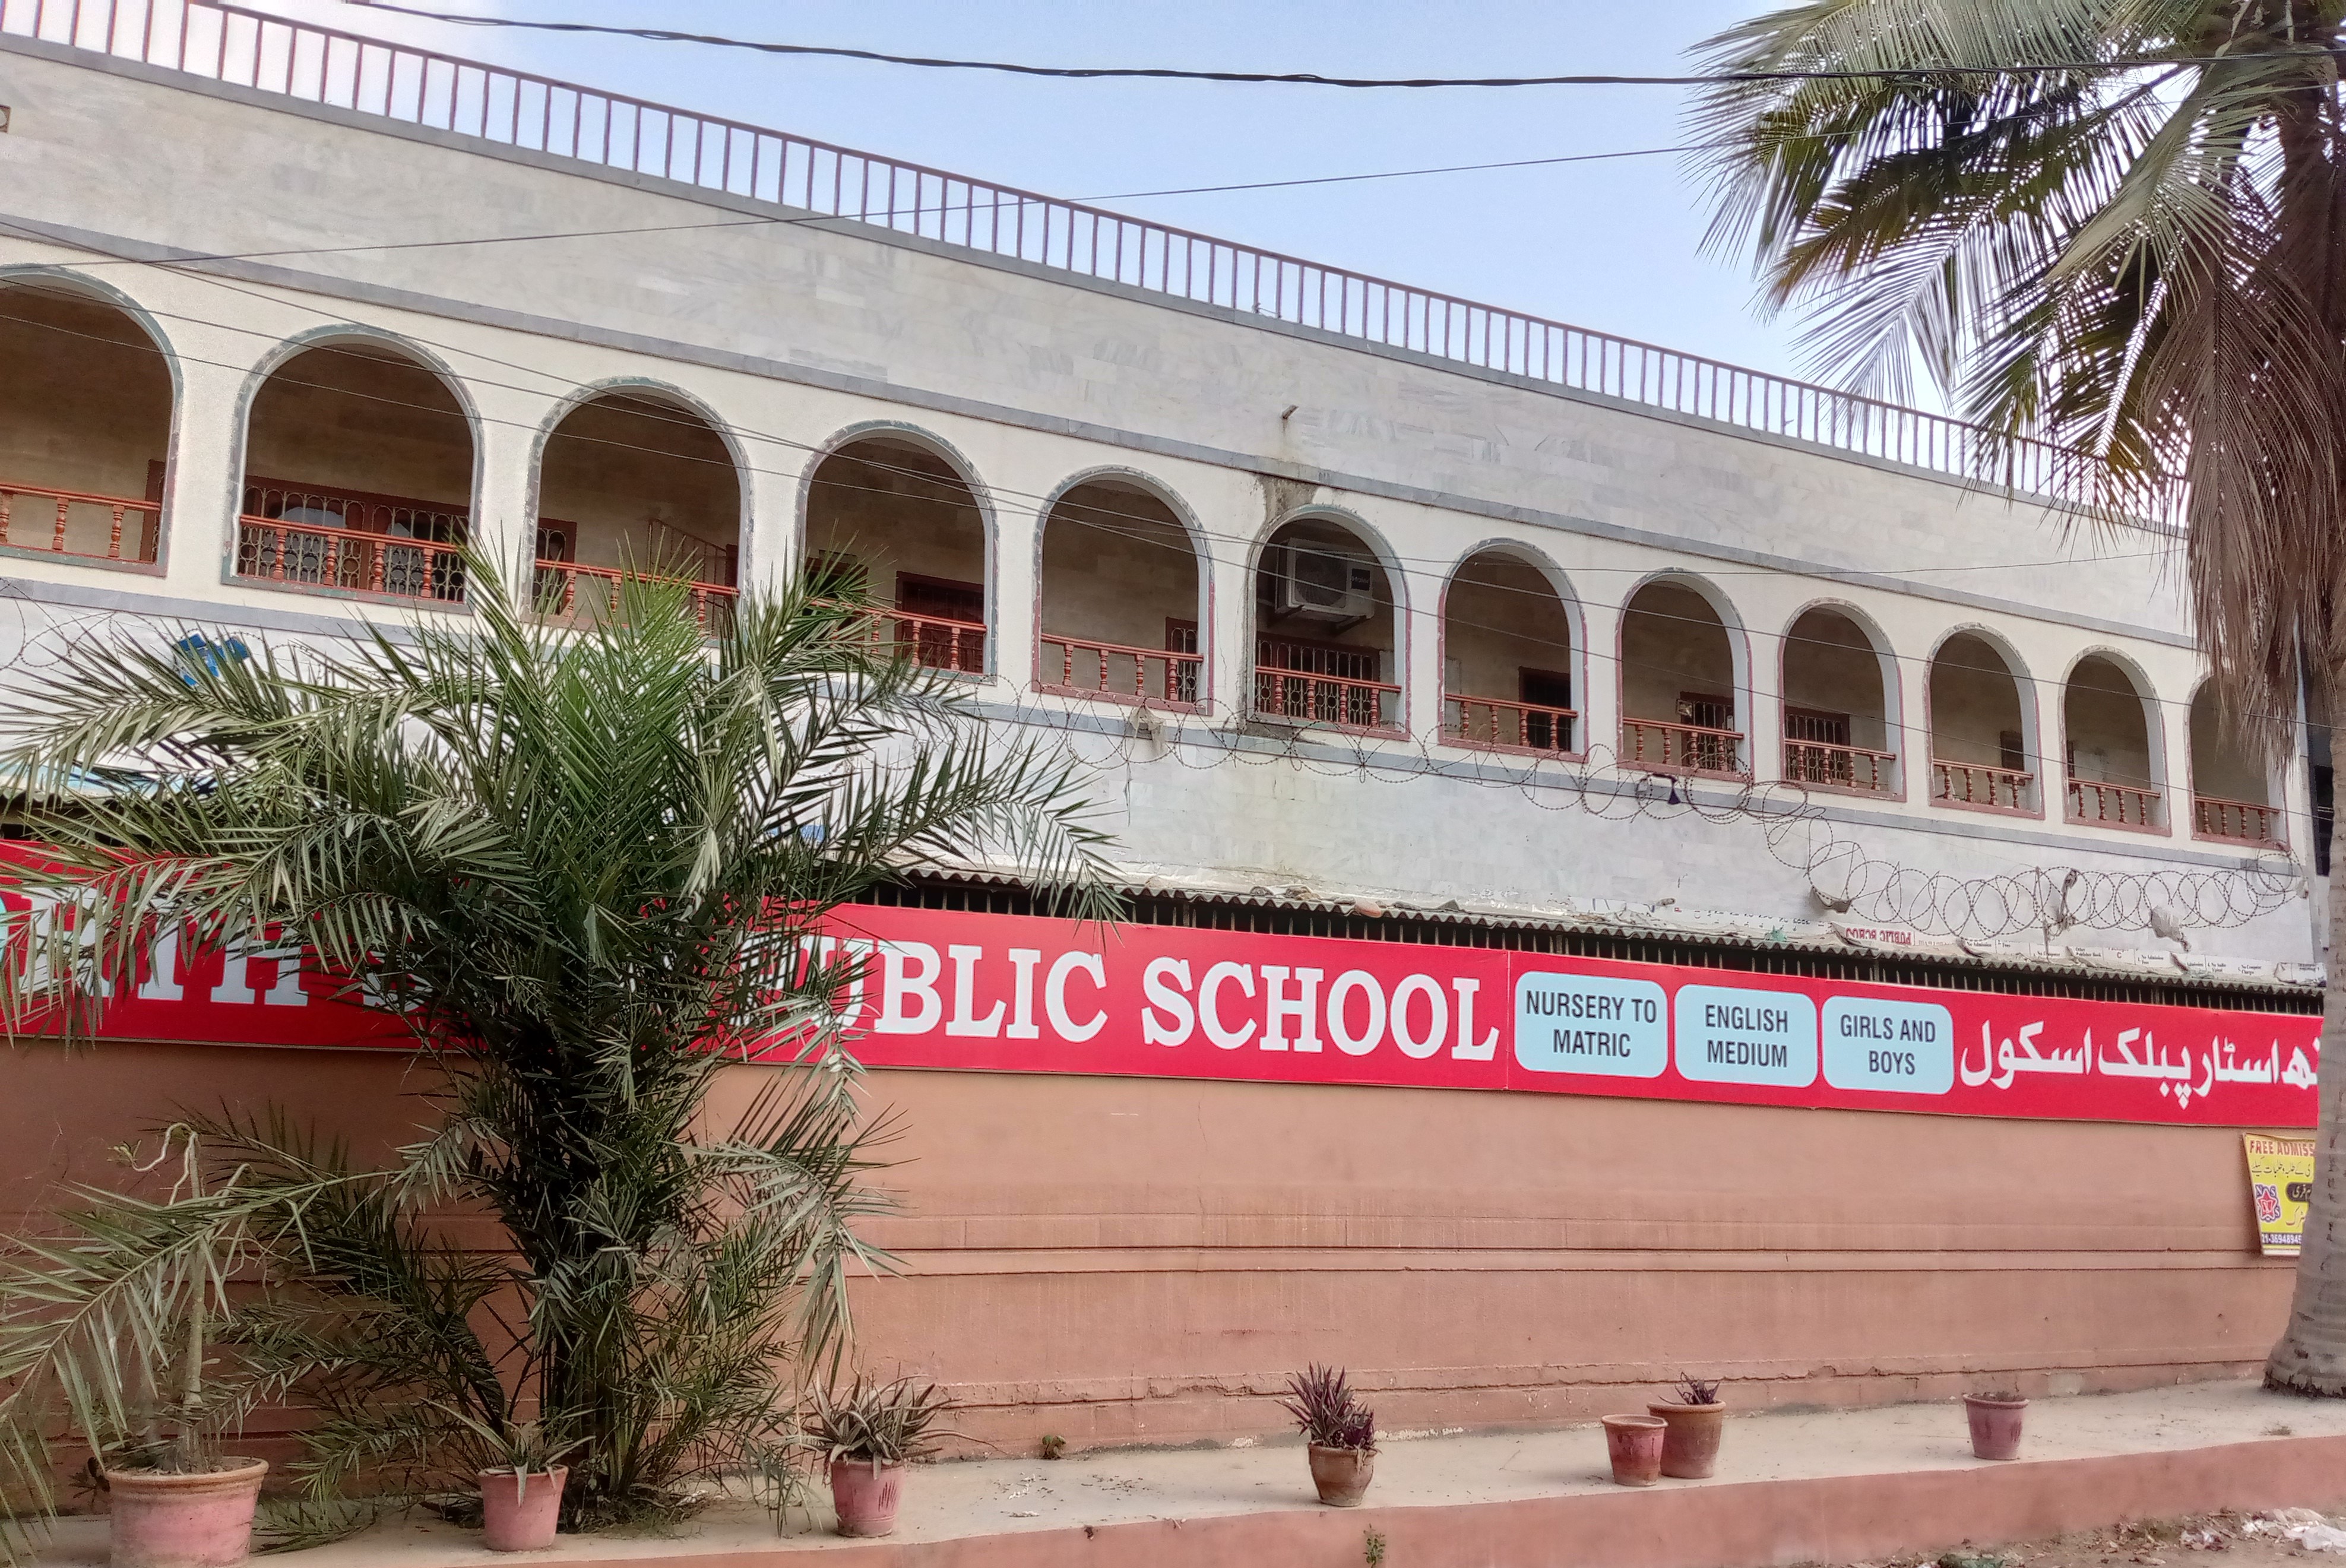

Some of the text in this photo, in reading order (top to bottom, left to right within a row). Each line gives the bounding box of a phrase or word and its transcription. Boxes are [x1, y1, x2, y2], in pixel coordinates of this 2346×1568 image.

[1141, 956, 1500, 1061] SCHOOL
[1526, 990, 1657, 1024] NURSERY TO
[1705, 1004, 1788, 1033] ENGLISH
[1841, 1014, 1936, 1043] GIRLS AND
[1553, 1029, 1631, 1058] MATRIC
[1707, 1040, 1787, 1068] MEDIUM
[1959, 1019, 2092, 1089] اسکول
[1869, 1050, 1916, 1075] BOYS
[2097, 1027, 2192, 1110] پبلک
[2192, 1035, 2280, 1097] اسٹار
[2250, 1140, 2274, 1155] FREE
